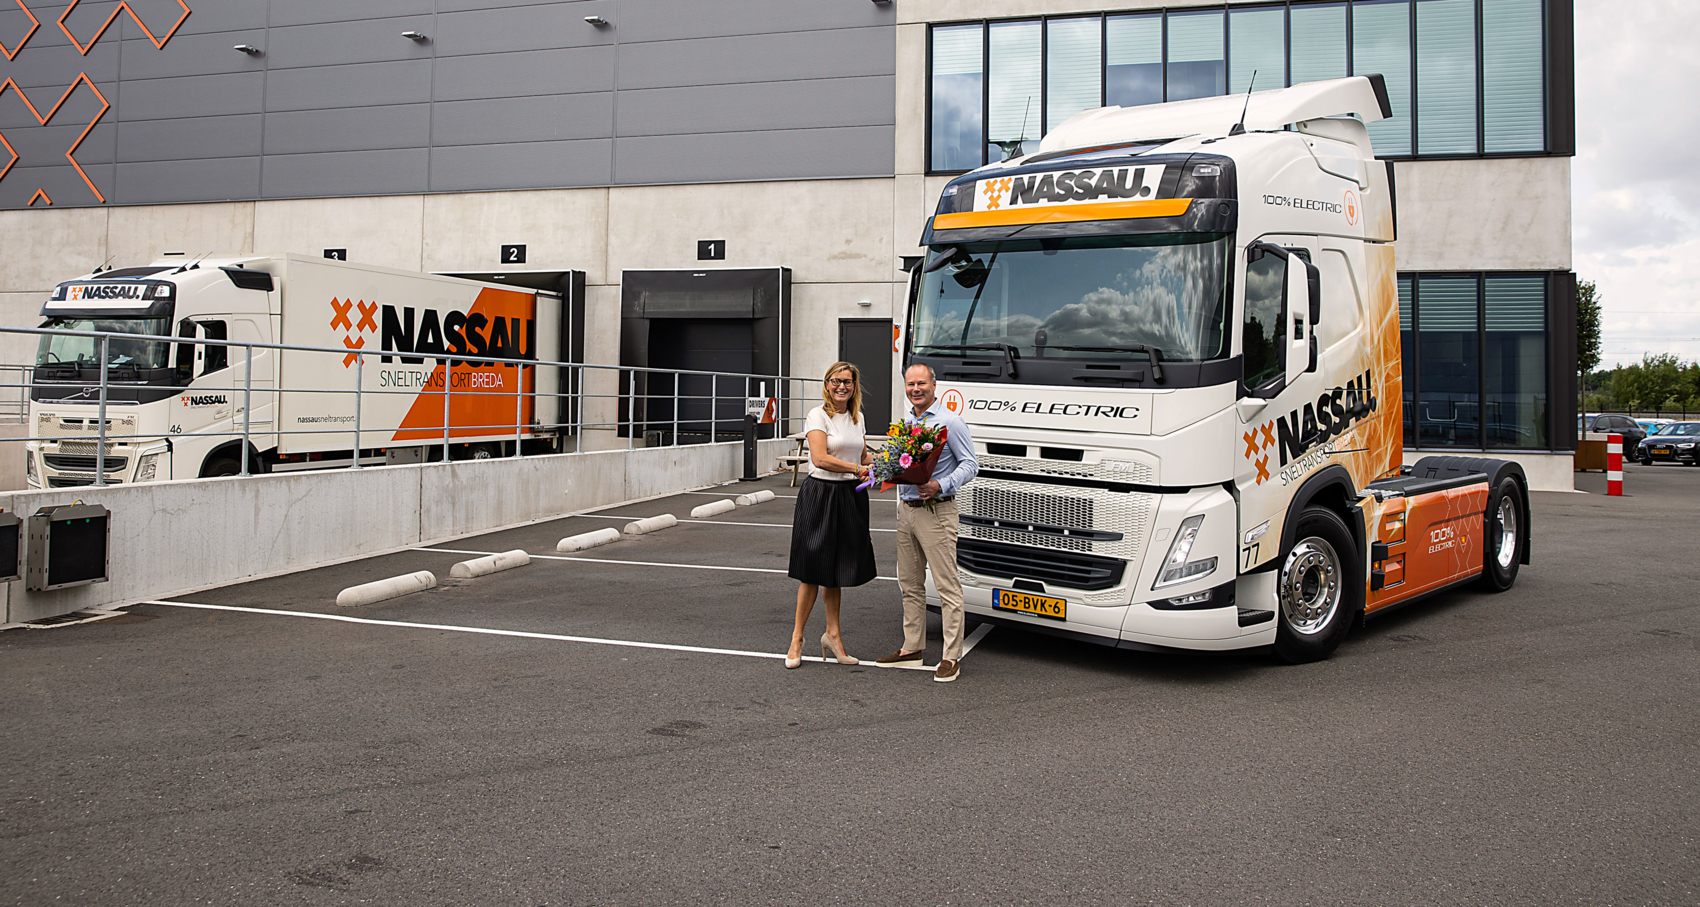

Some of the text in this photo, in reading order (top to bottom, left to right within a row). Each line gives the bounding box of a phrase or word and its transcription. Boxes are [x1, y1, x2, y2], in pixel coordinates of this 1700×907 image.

[1009, 167, 1151, 206] NASSAU.
[1262, 194, 1342, 214] 100% ELECTRIC
[331, 251, 339, 260] 3
[509, 247, 518, 261] 2
[707, 243, 715, 257] 1
[82, 285, 140, 300] NASSAU.
[381, 304, 534, 370] NASSAU
[380, 370, 504, 388] SNELTRANSORTBREDA
[190, 394, 228, 406] NASSAU.
[749, 400, 766, 408] DRIVERS
[967, 398, 1140, 420] 100% ELECTRIC
[1276, 368, 1377, 468] NASSAU.
[169, 424, 182, 434] 46
[1429, 526, 1454, 544] 100%
[1242, 542, 1260, 569] 77
[1428, 539, 1455, 554] ELECTRIC
[1002, 593, 1061, 615] 05-BVK-6
